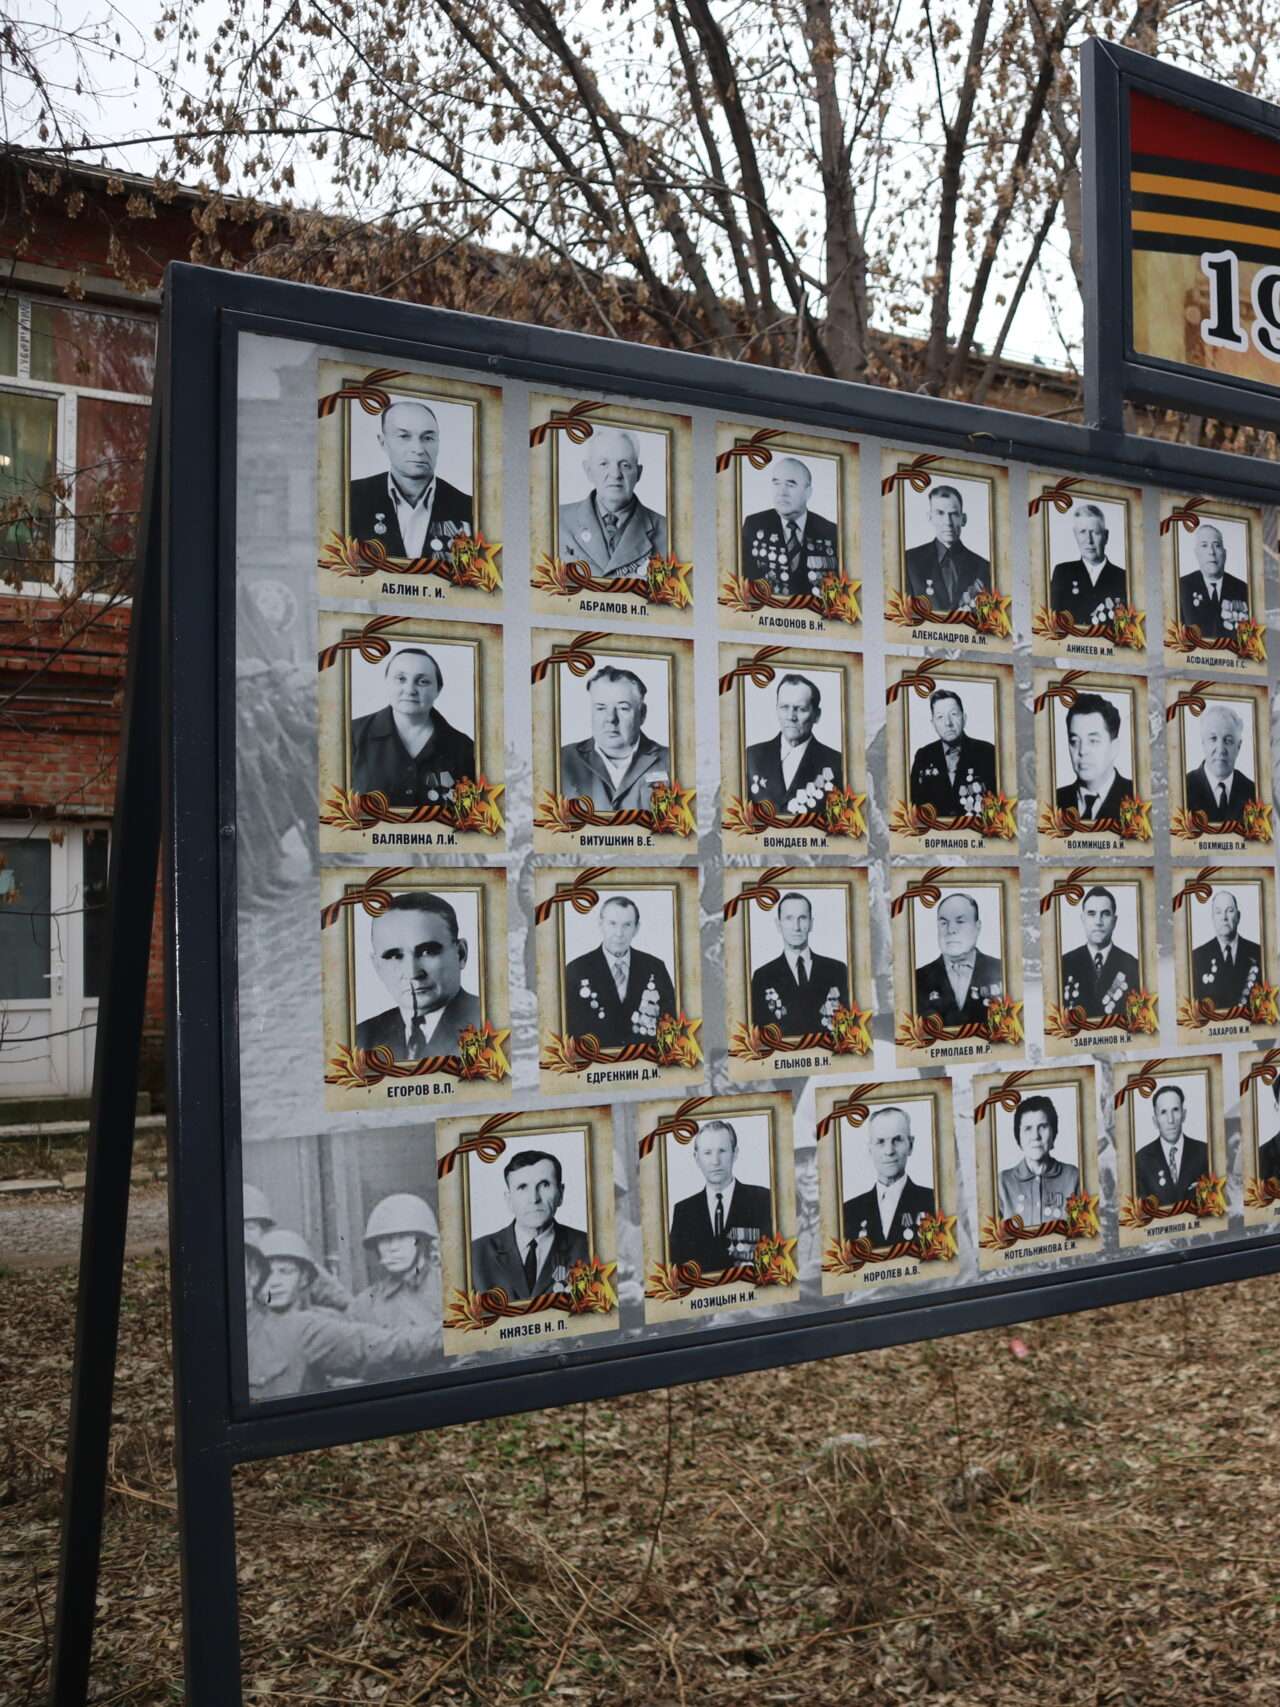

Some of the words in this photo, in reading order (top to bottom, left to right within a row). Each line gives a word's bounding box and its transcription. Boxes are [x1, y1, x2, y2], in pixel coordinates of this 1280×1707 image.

[381, 582, 419, 597] АБЛИН
[579, 599, 628, 614] АБРАМОВ
[758, 615, 807, 629] АГАФОНОВ
[912, 628, 969, 644] АЛЕКСАНДРОВ
[971, 635, 988, 646] А.М.
[1066, 643, 1098, 655] АНИКЕЕВ
[372, 833, 432, 845] ВАЛЯВИНА
[436, 834, 457, 845] Л.И.
[580, 835, 634, 846] ВИТУШКИН
[636, 836, 654, 846] В.Е.
[763, 837, 807, 848] ВОЖДАЕВ
[924, 838, 968, 848] ВОРМАНОВ
[1067, 840, 1110, 849] ВОХМИНЦЕВ
[1074, 1034, 1116, 1047] ЗАВРАЖНОВ
[930, 1045, 973, 1058] ЕРМОЛАЕВ
[975, 1044, 992, 1054] М.Р.
[774, 1057, 813, 1070] ЕЛЫКОВ
[586, 1069, 638, 1084] ЕДРЕНКИН
[387, 1084, 431, 1098] ЕГОРОВ
[433, 1082, 454, 1095] В.П.
[1004, 1242, 1062, 1260] КОТЕЛЬНИКОВА
[863, 1267, 902, 1283] КОРОЛЕВ
[904, 1264, 920, 1276] А.В.
[690, 1292, 737, 1311] КОЗИЦЫН
[499, 1322, 541, 1340] КНЯЗЕВ
